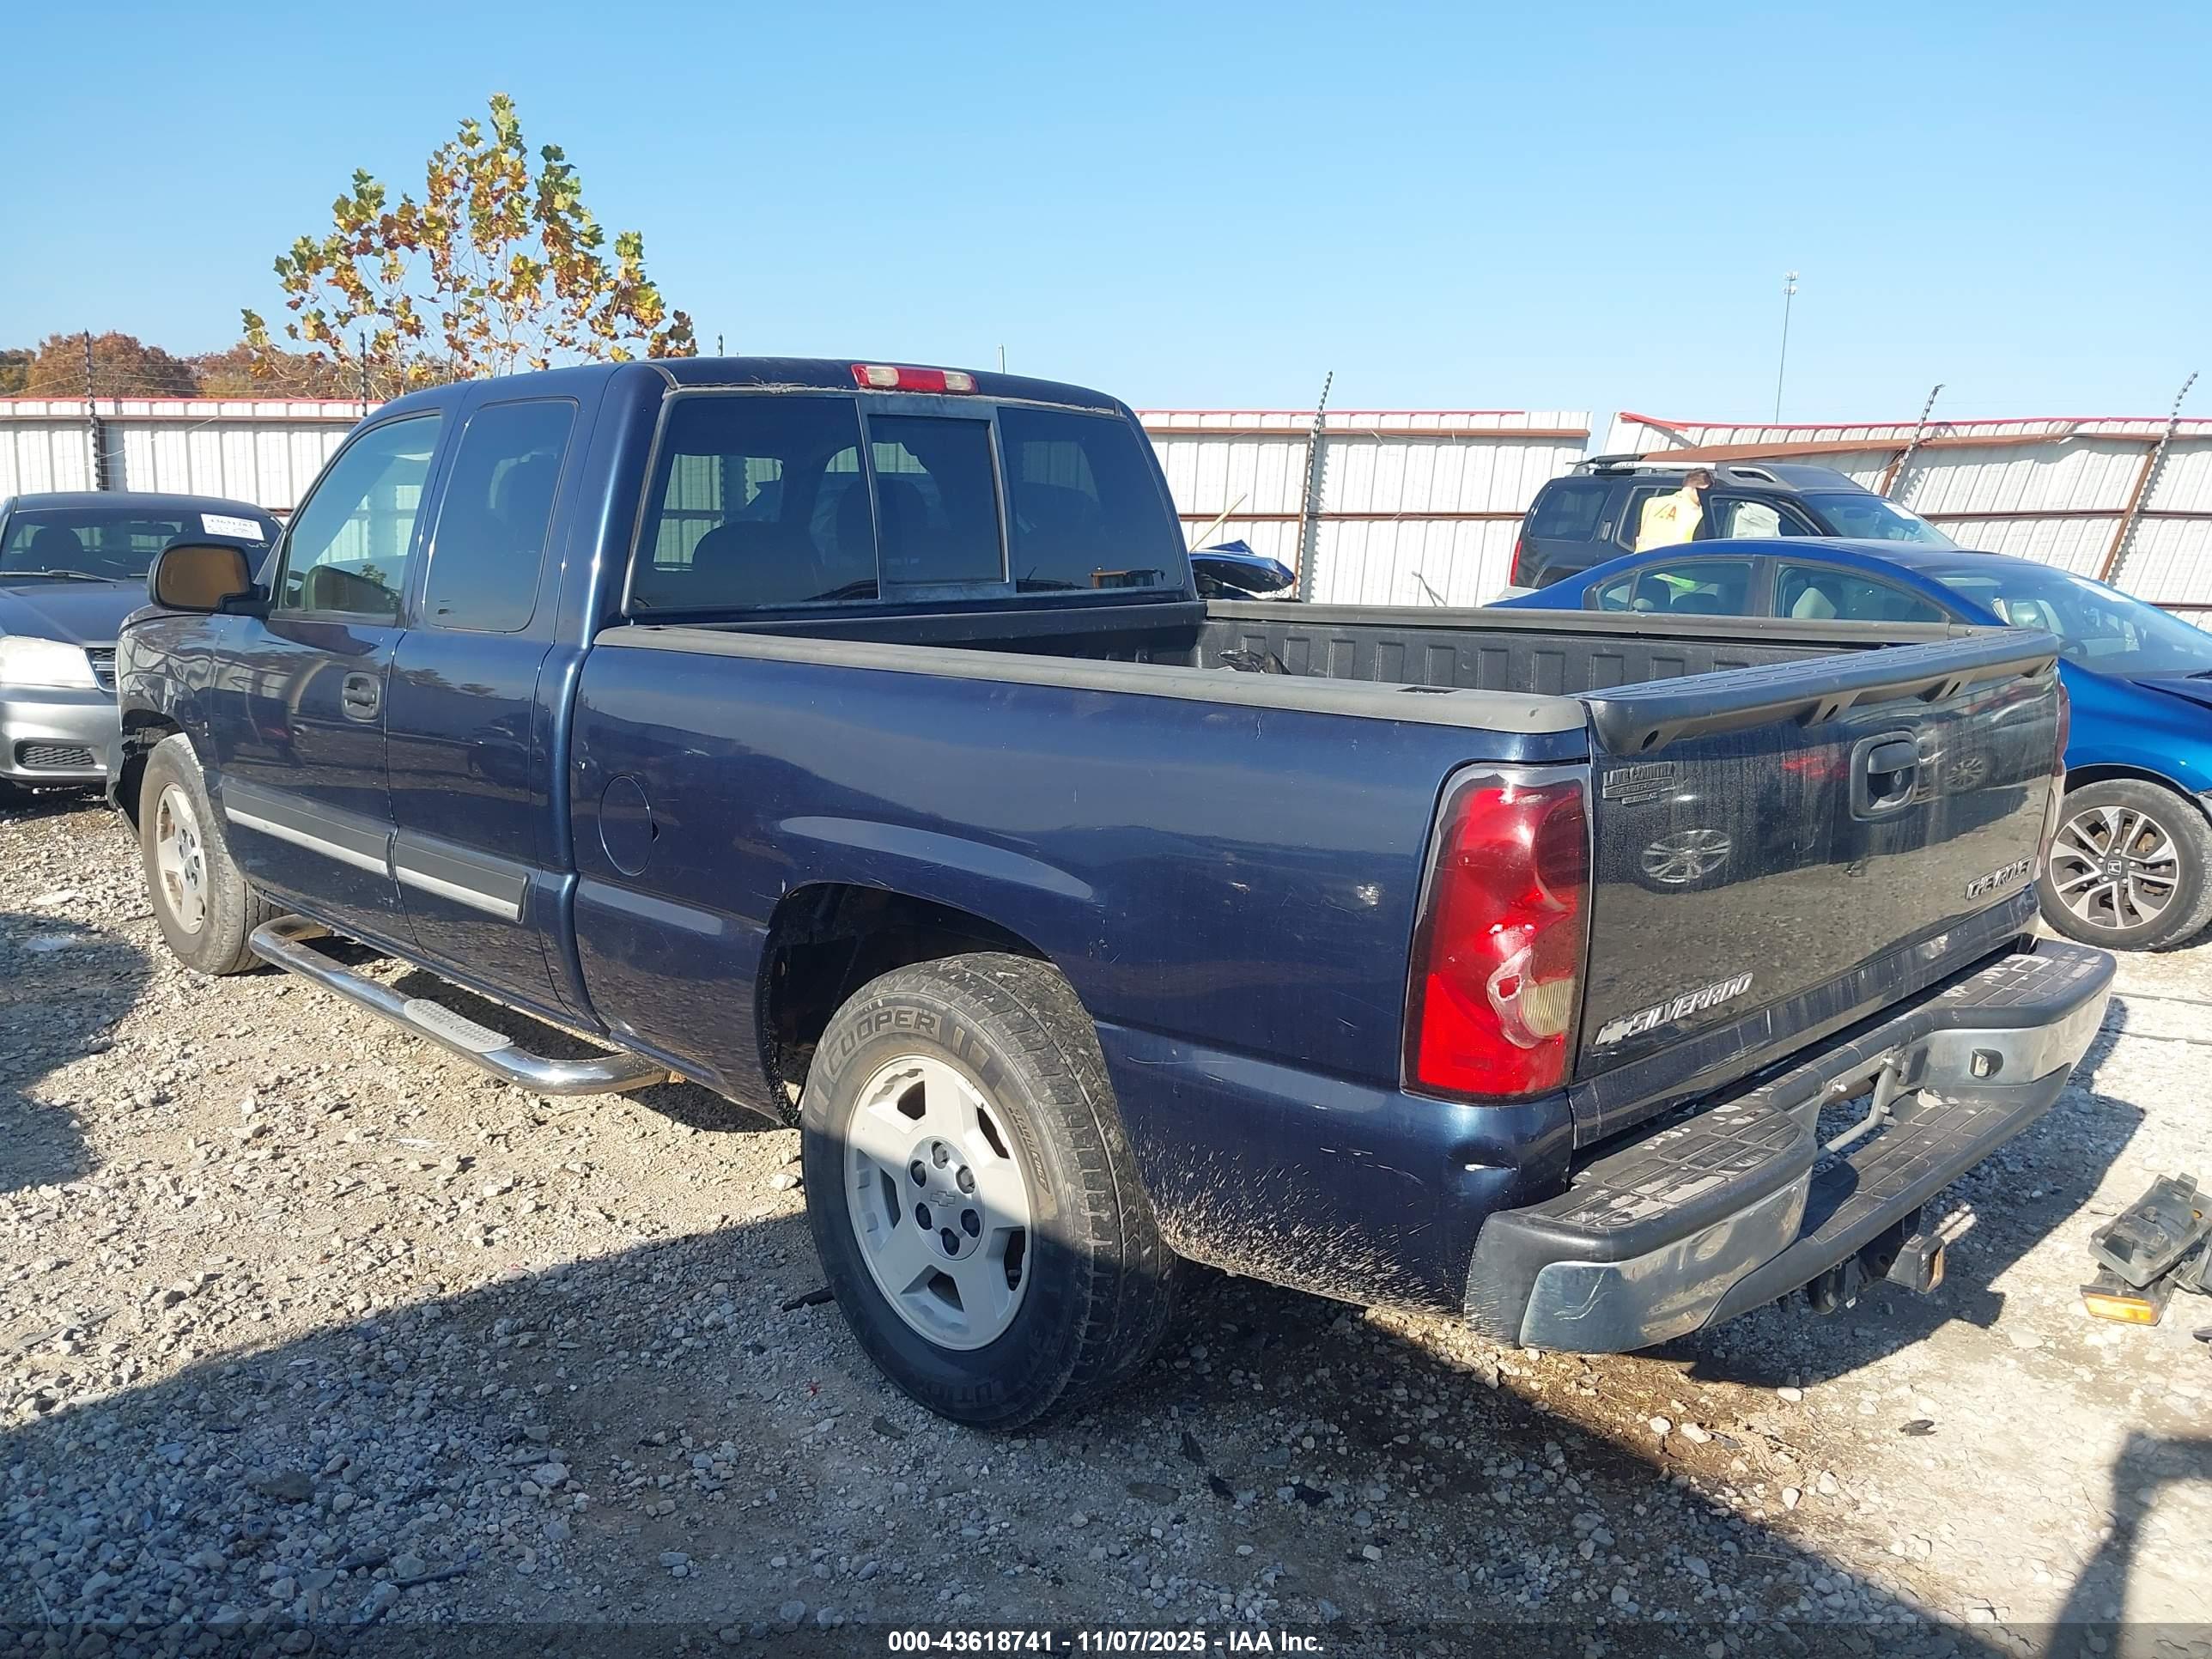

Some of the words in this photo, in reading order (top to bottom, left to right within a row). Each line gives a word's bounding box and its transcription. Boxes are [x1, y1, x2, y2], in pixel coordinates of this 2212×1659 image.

[1966, 856, 2033, 900] CHEVROLET
[1629, 971, 1753, 1036] SILVERADO
[828, 1009, 936, 1073] COOPER
